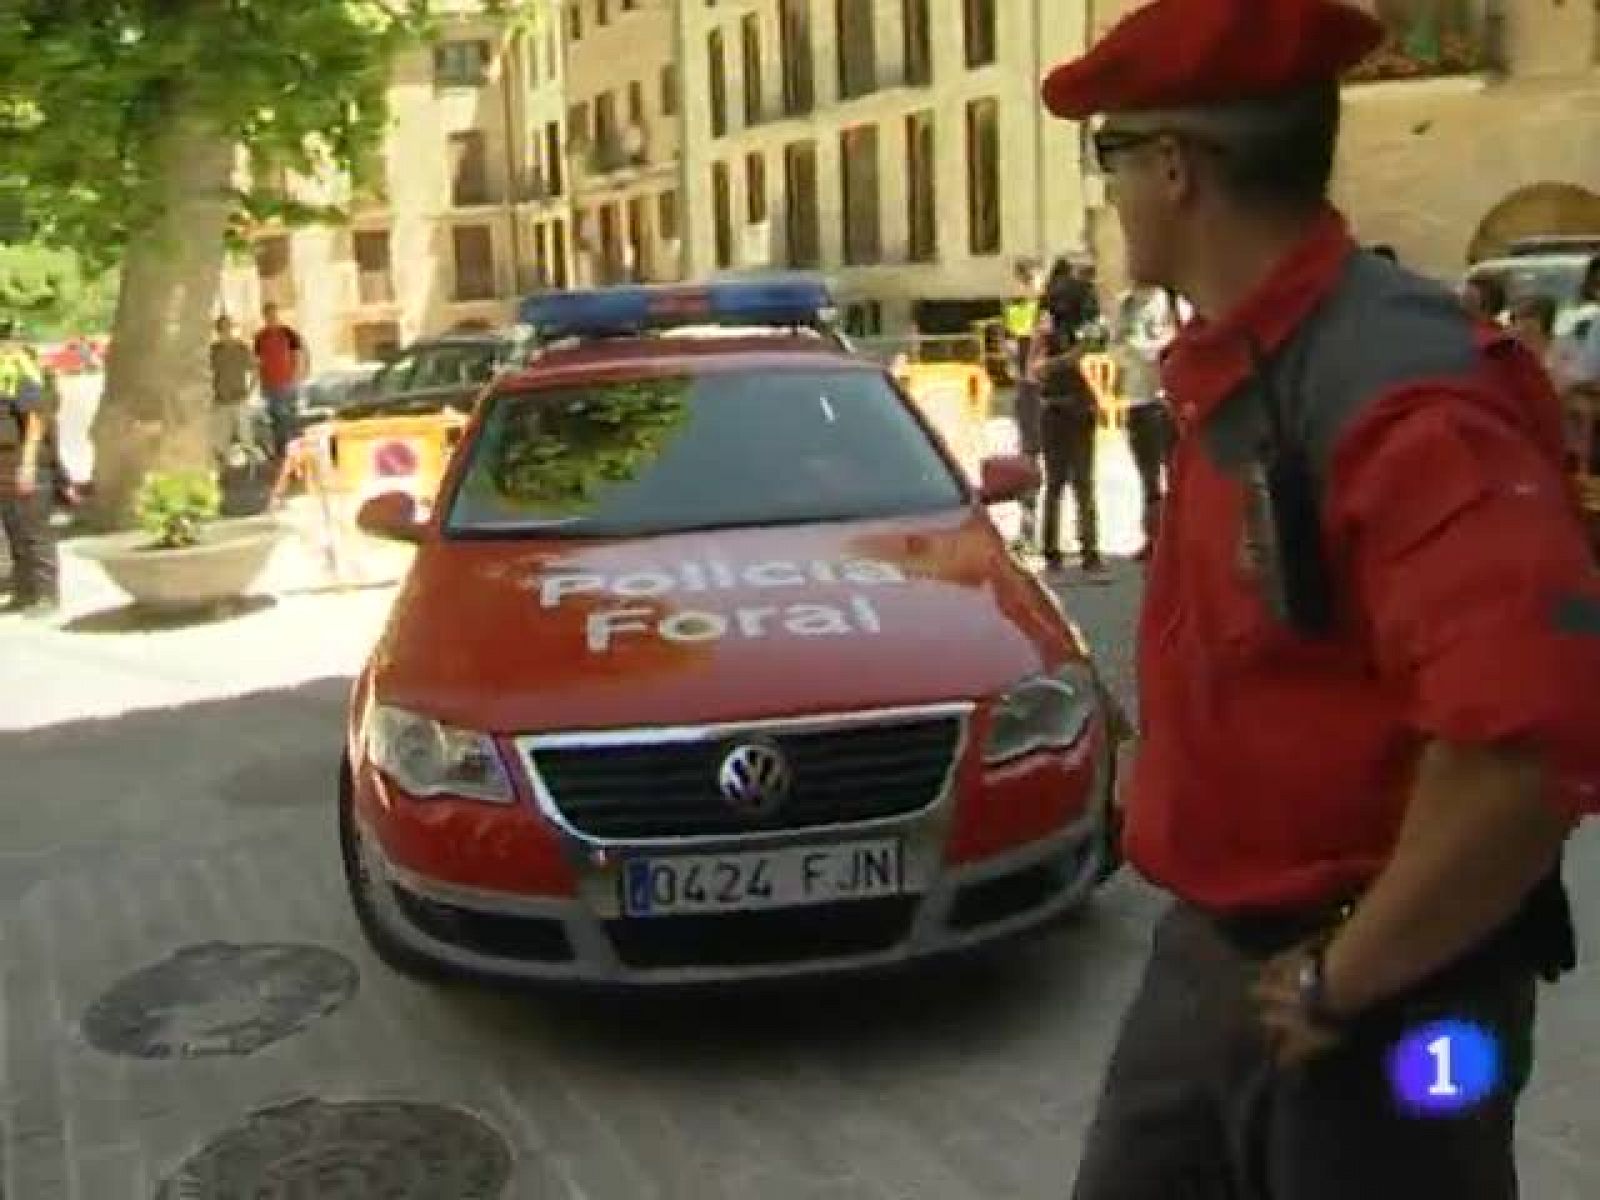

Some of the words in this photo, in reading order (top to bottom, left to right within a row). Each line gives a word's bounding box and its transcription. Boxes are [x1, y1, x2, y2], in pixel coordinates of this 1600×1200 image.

[585, 595, 881, 652] Foral
[652, 857, 773, 906] 0424
[802, 847, 892, 896] FJN
